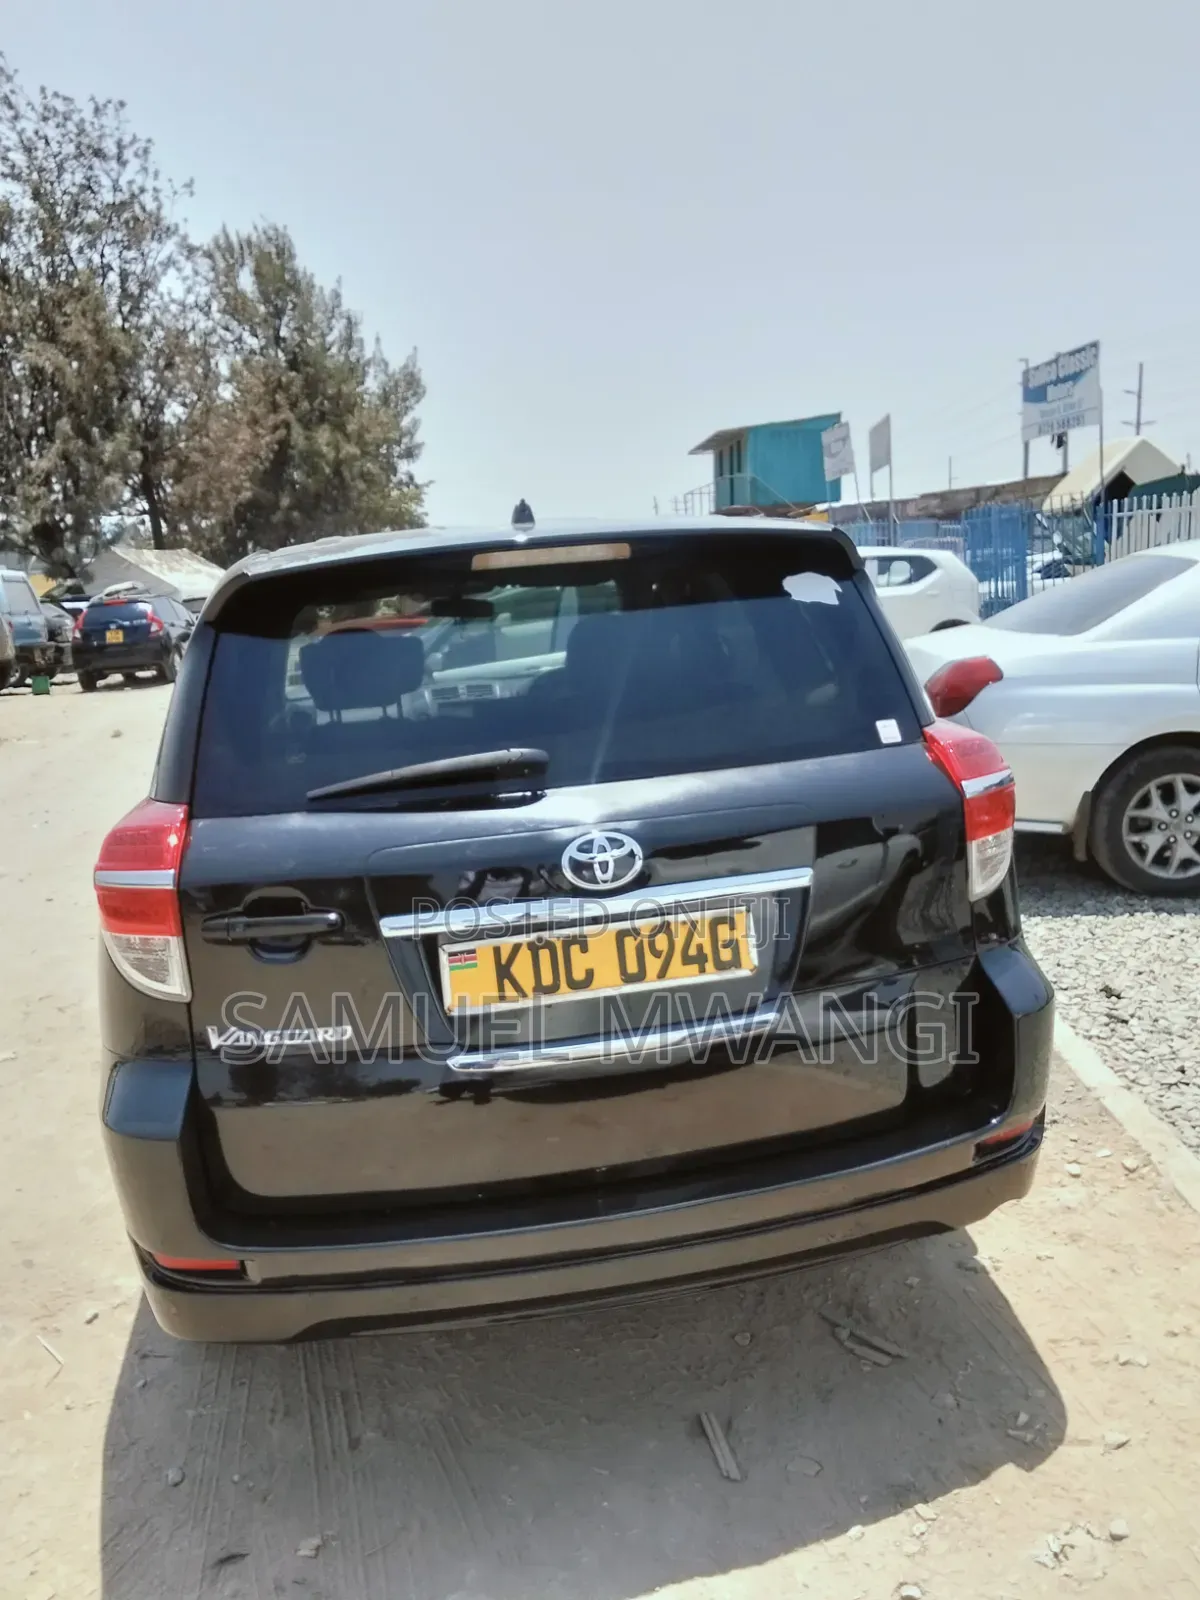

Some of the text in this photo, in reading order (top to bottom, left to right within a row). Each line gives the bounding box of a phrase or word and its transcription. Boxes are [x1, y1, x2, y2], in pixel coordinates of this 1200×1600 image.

[492, 915, 741, 1001] KDC 094G
[206, 1025, 352, 1050] VANGUARD
